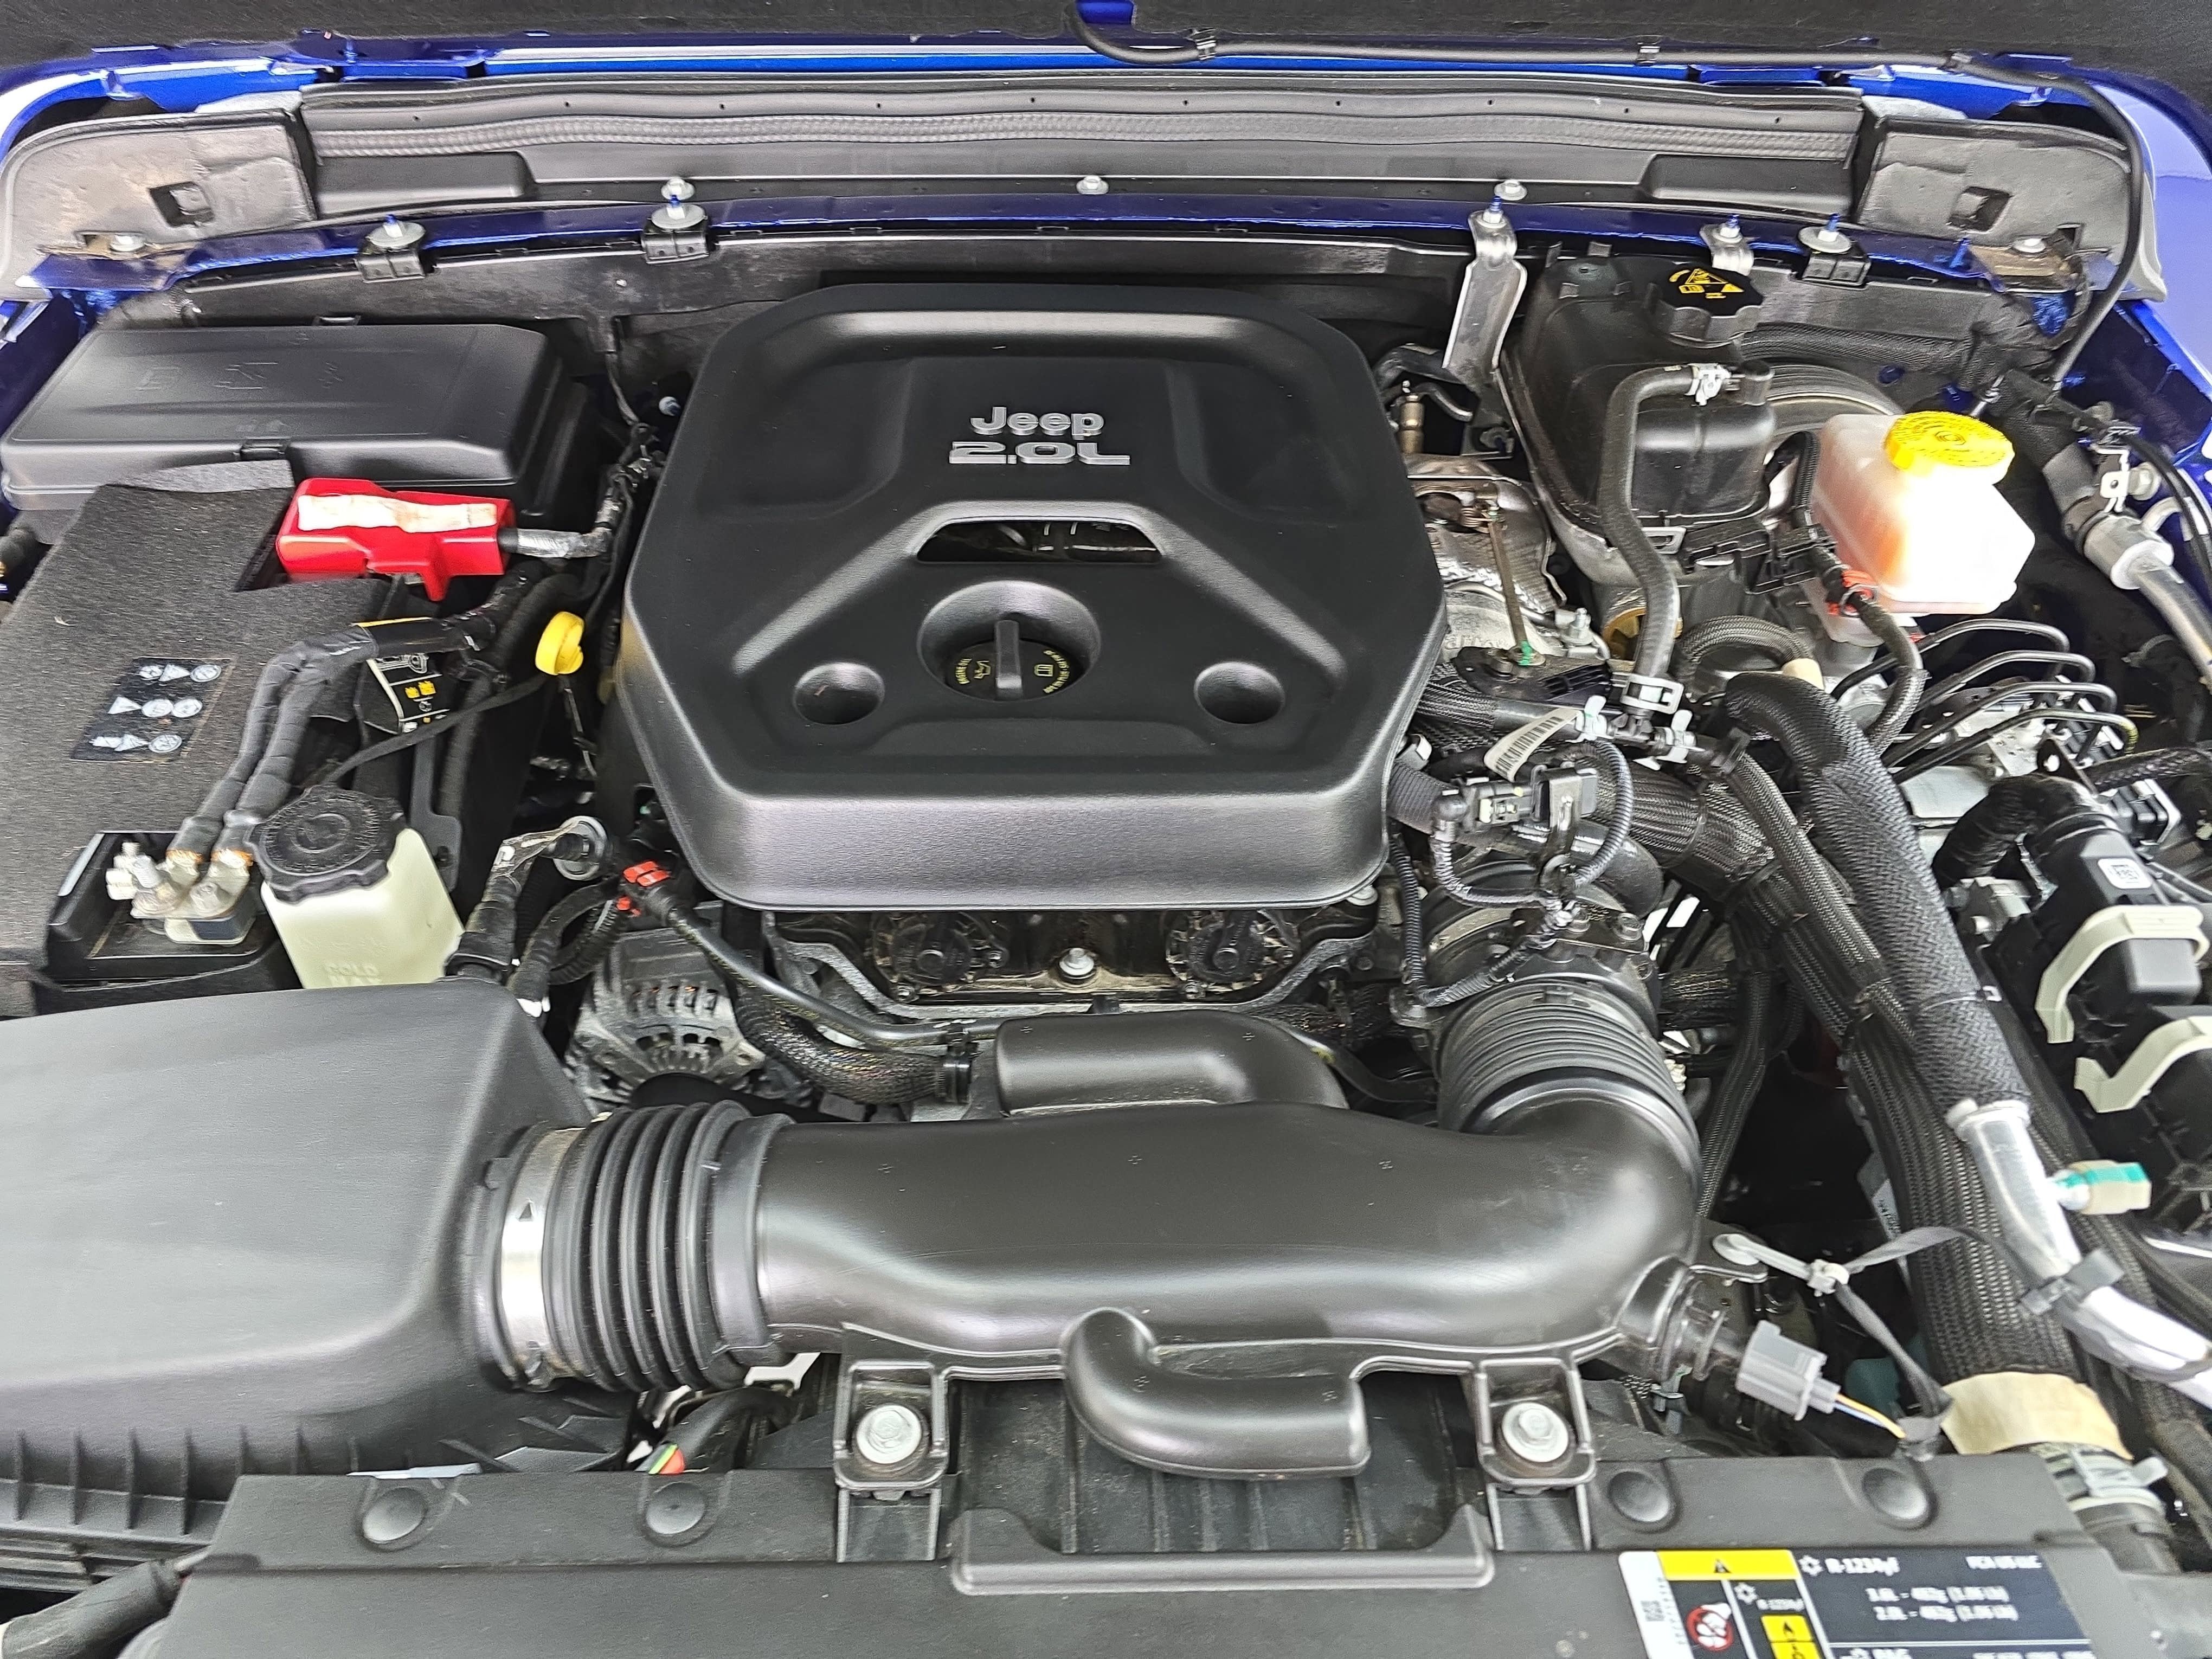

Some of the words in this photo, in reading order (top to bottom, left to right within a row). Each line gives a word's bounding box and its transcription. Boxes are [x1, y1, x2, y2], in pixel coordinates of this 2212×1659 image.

[969, 407, 1105, 440] Jeep
[949, 441, 1130, 465] 2.0L
[955, 667, 970, 685] ENGINE
